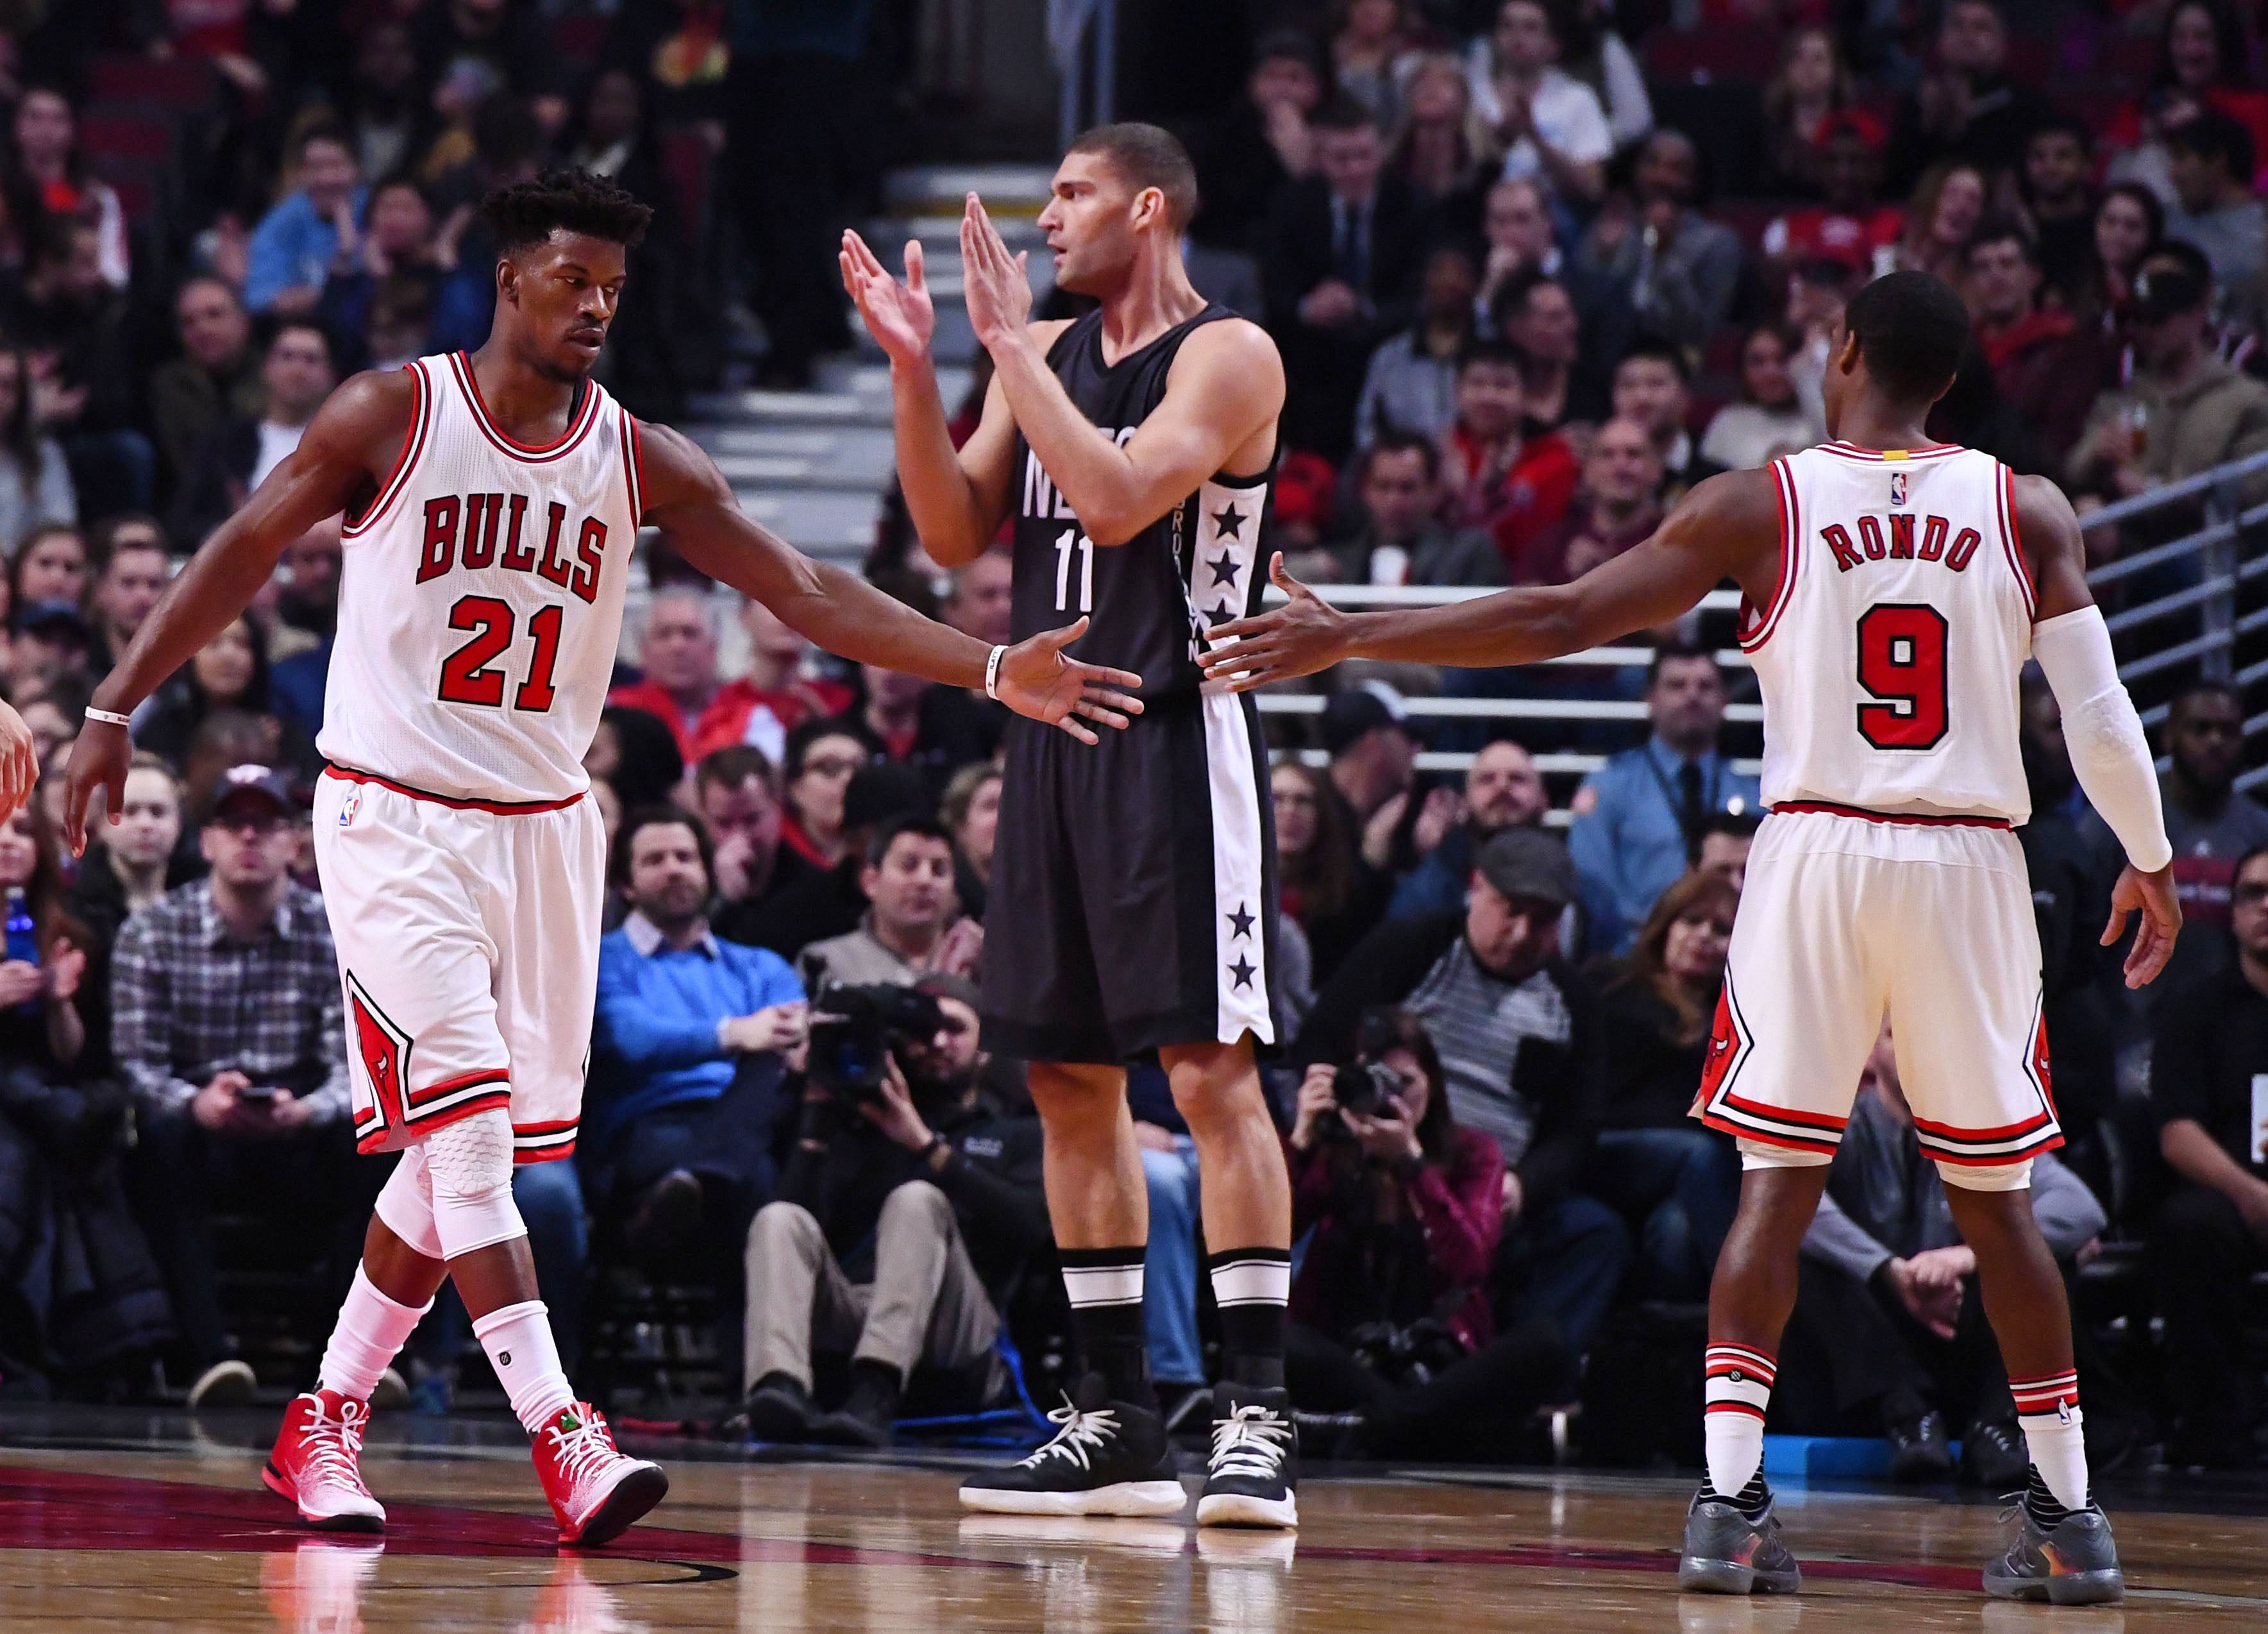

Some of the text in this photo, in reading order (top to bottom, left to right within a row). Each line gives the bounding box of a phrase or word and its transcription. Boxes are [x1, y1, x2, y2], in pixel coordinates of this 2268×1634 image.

[416, 493, 608, 605] BULLS
[1055, 528, 1093, 612] 11
[1820, 514, 1981, 573] RONDO
[437, 595, 564, 712] 21
[1856, 603, 1949, 750] 9
